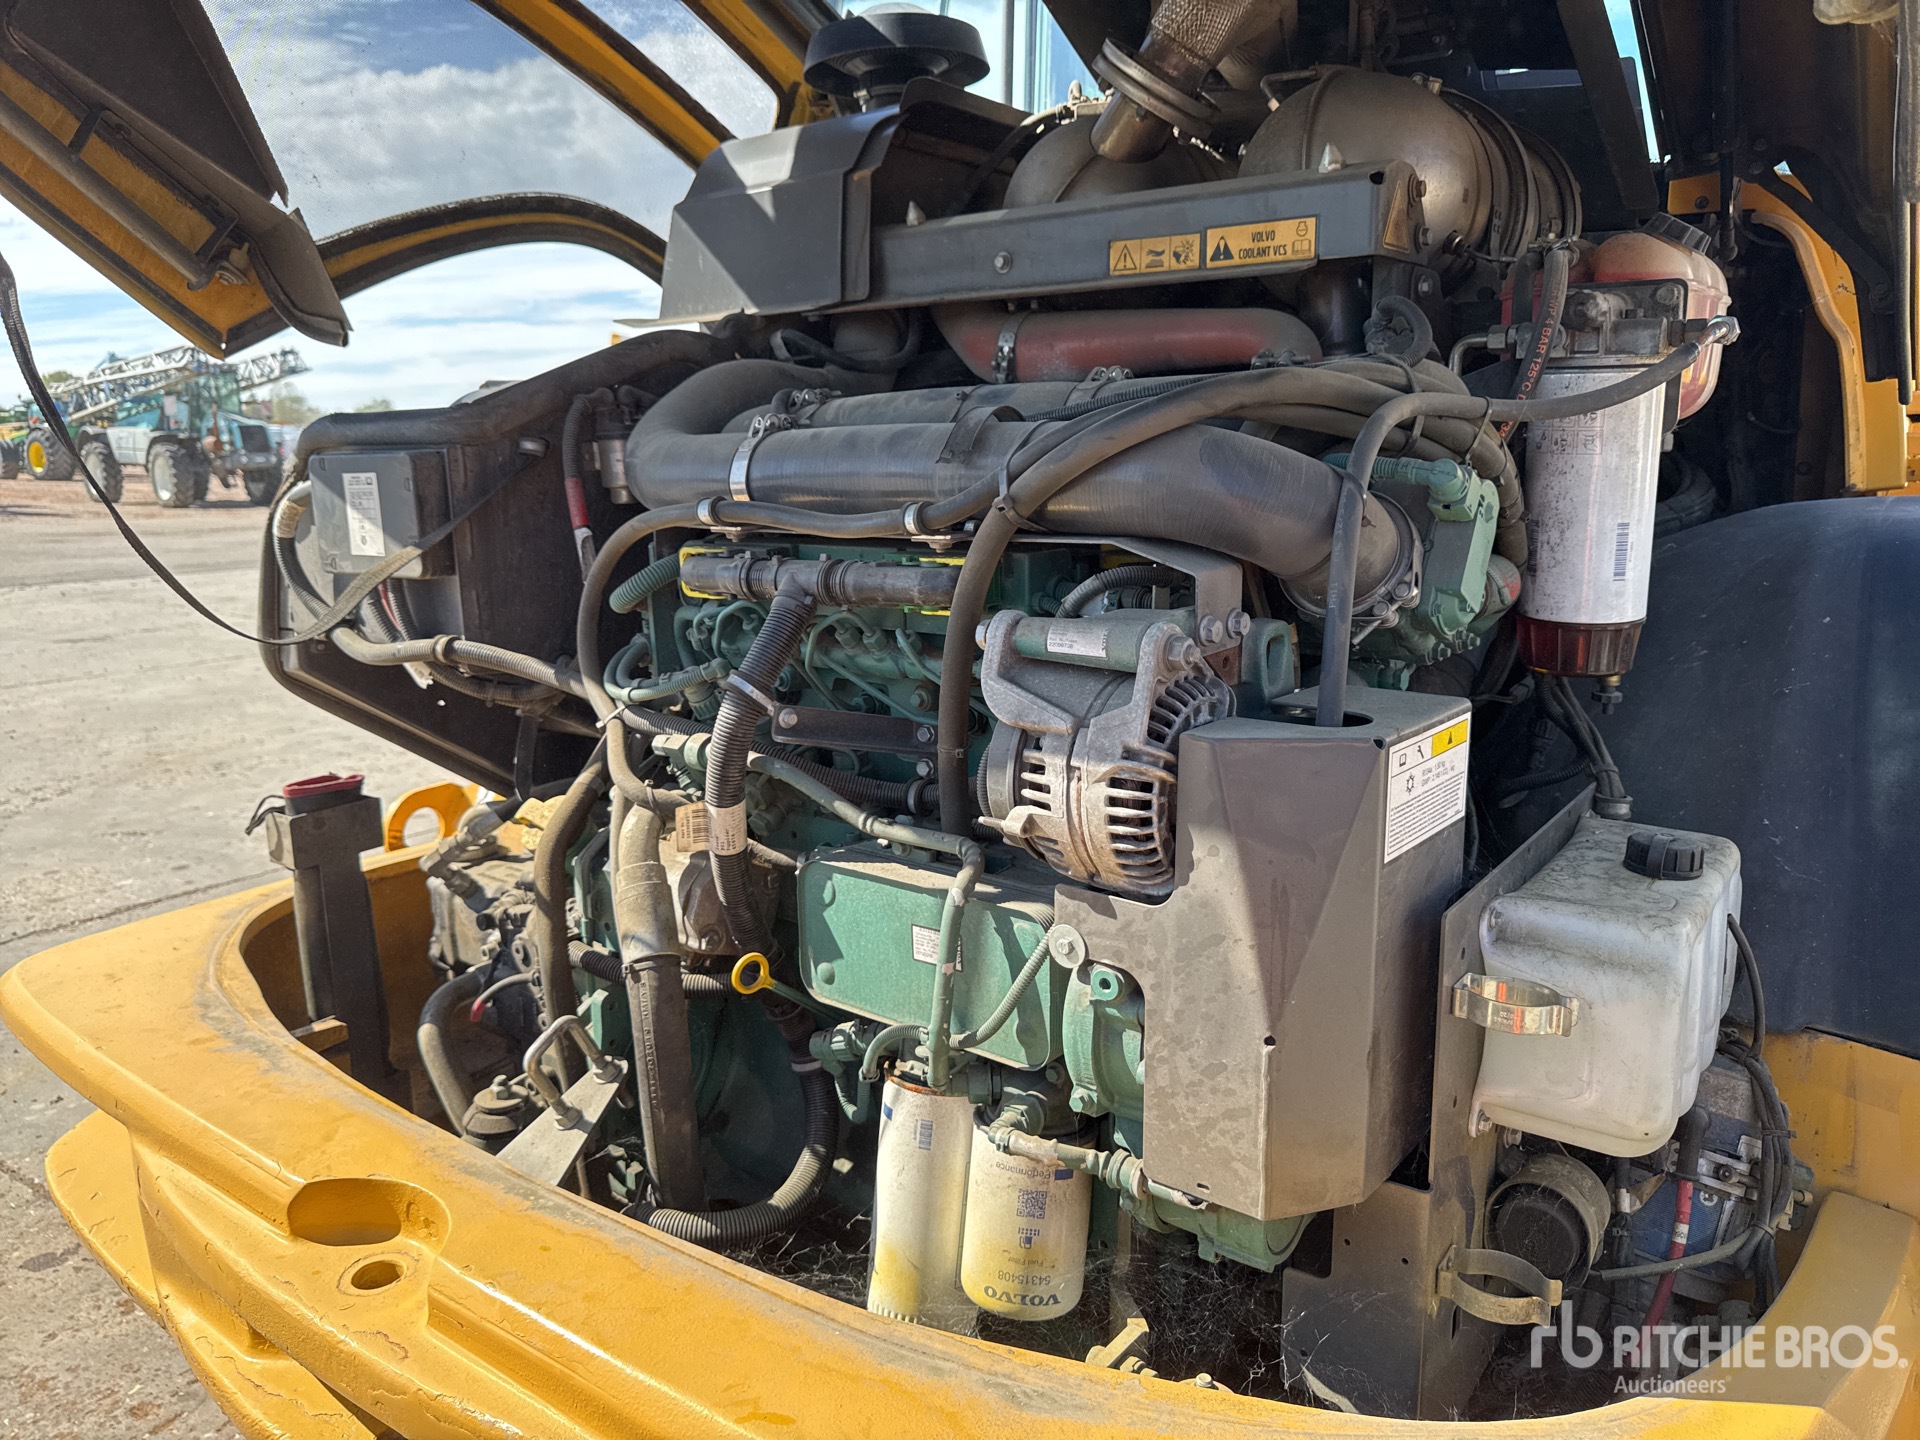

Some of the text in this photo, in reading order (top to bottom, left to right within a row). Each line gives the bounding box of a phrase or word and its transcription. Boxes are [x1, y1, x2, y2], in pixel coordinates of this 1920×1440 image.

[1251, 231, 1276, 242] VOLVO
[1239, 245, 1287, 259] COOLANT VCS
[1536, 327, 1552, 354] BAR
[1522, 357, 1542, 391] 125°C
[995, 1161, 1052, 1180] Performance
[1007, 1256, 1044, 1267] Fuel Filter
[997, 1270, 1051, 1286] 54315408
[983, 1285, 1061, 1306] VOLVO
